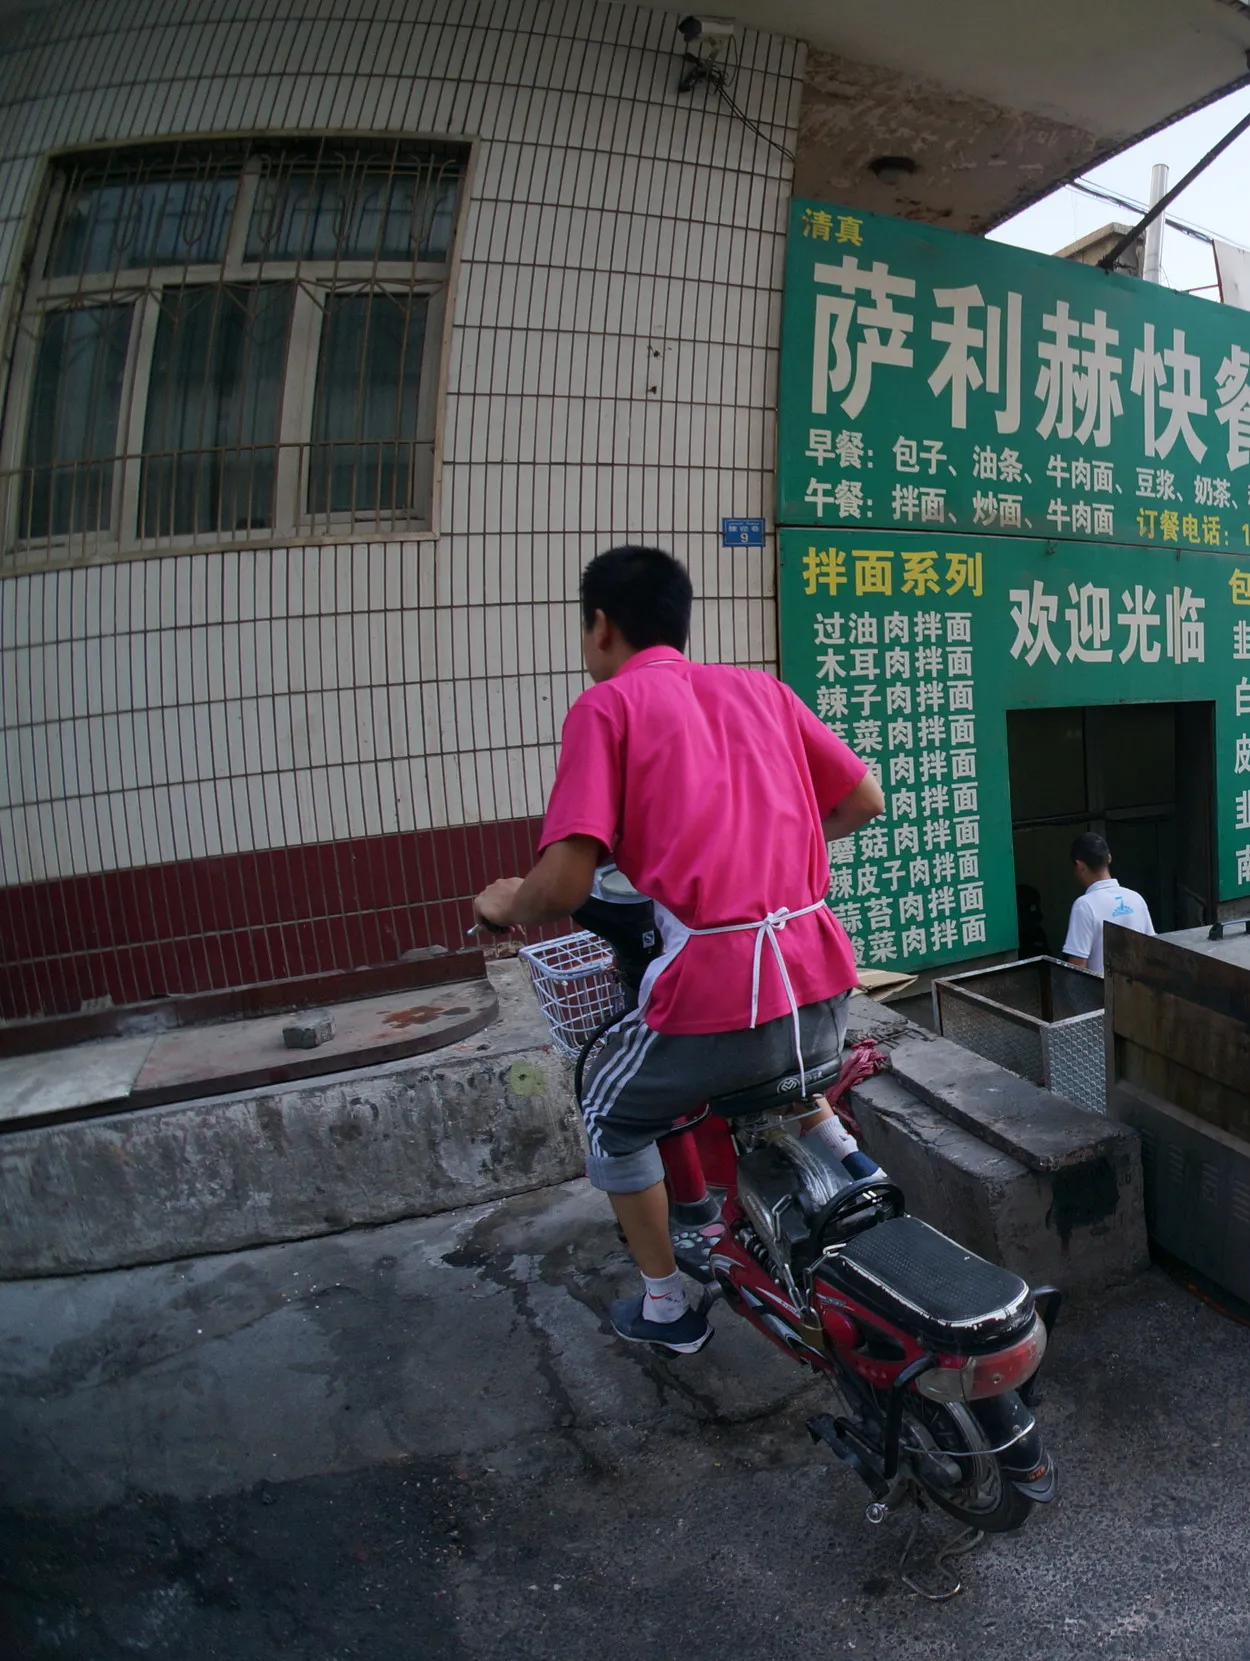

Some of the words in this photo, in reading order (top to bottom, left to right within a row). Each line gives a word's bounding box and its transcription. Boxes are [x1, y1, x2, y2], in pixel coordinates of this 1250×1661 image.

[801, 208, 864, 247] 清真
[740, 533, 748, 542] 9
[803, 547, 983, 597] 拌面系列
[814, 611, 972, 645] 过油肉拌面
[1009, 580, 1206, 666] 欢迎光临
[816, 646, 973, 682] 木耳肉拌面
[816, 680, 974, 718] 辣子肉拌面
[829, 849, 979, 900] 辣皮子肉拌面
[832, 881, 984, 933] 蒜苔肉拌面
